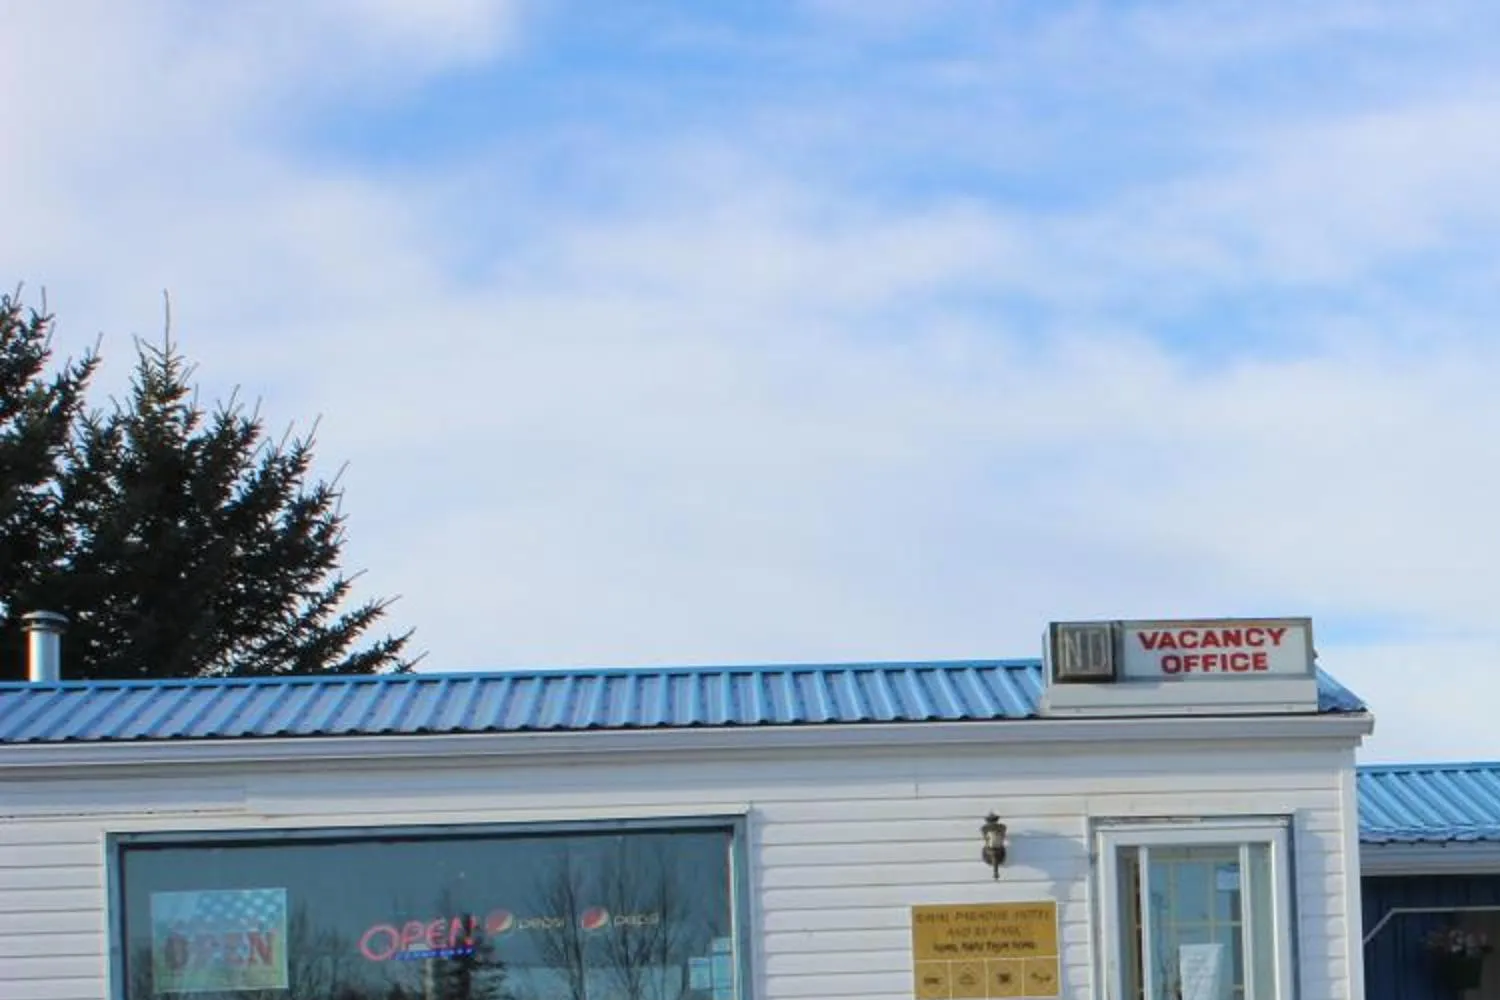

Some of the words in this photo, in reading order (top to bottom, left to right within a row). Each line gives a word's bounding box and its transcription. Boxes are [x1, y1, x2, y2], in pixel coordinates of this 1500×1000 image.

[1137, 627, 1287, 650] VACANCY
[1161, 652, 1269, 674] OFFICE
[163, 929, 275, 970] OPEN
[356, 914, 477, 961] OPEN
